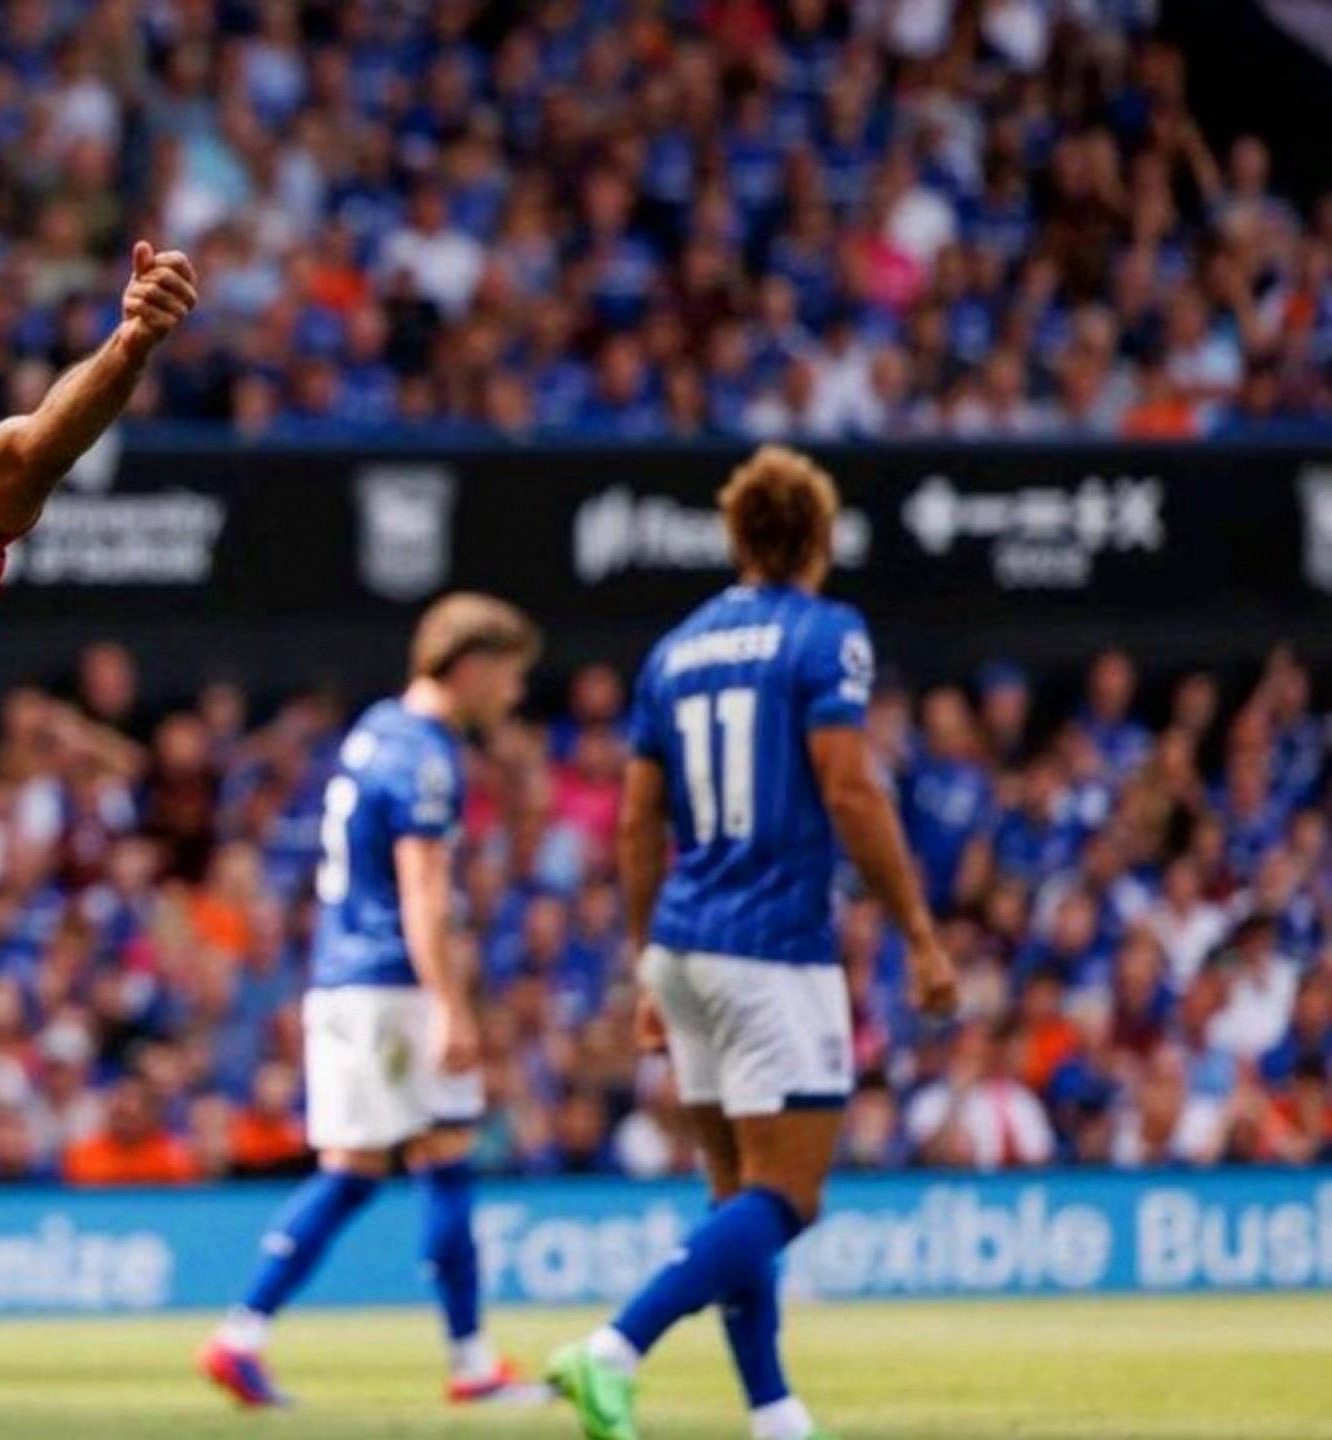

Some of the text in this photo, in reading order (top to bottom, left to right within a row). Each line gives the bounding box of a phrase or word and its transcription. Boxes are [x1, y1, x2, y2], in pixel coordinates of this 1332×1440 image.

[674, 687, 757, 844] 11
[470, 1200, 681, 1301] Fast
[783, 1184, 1113, 1292] exible
